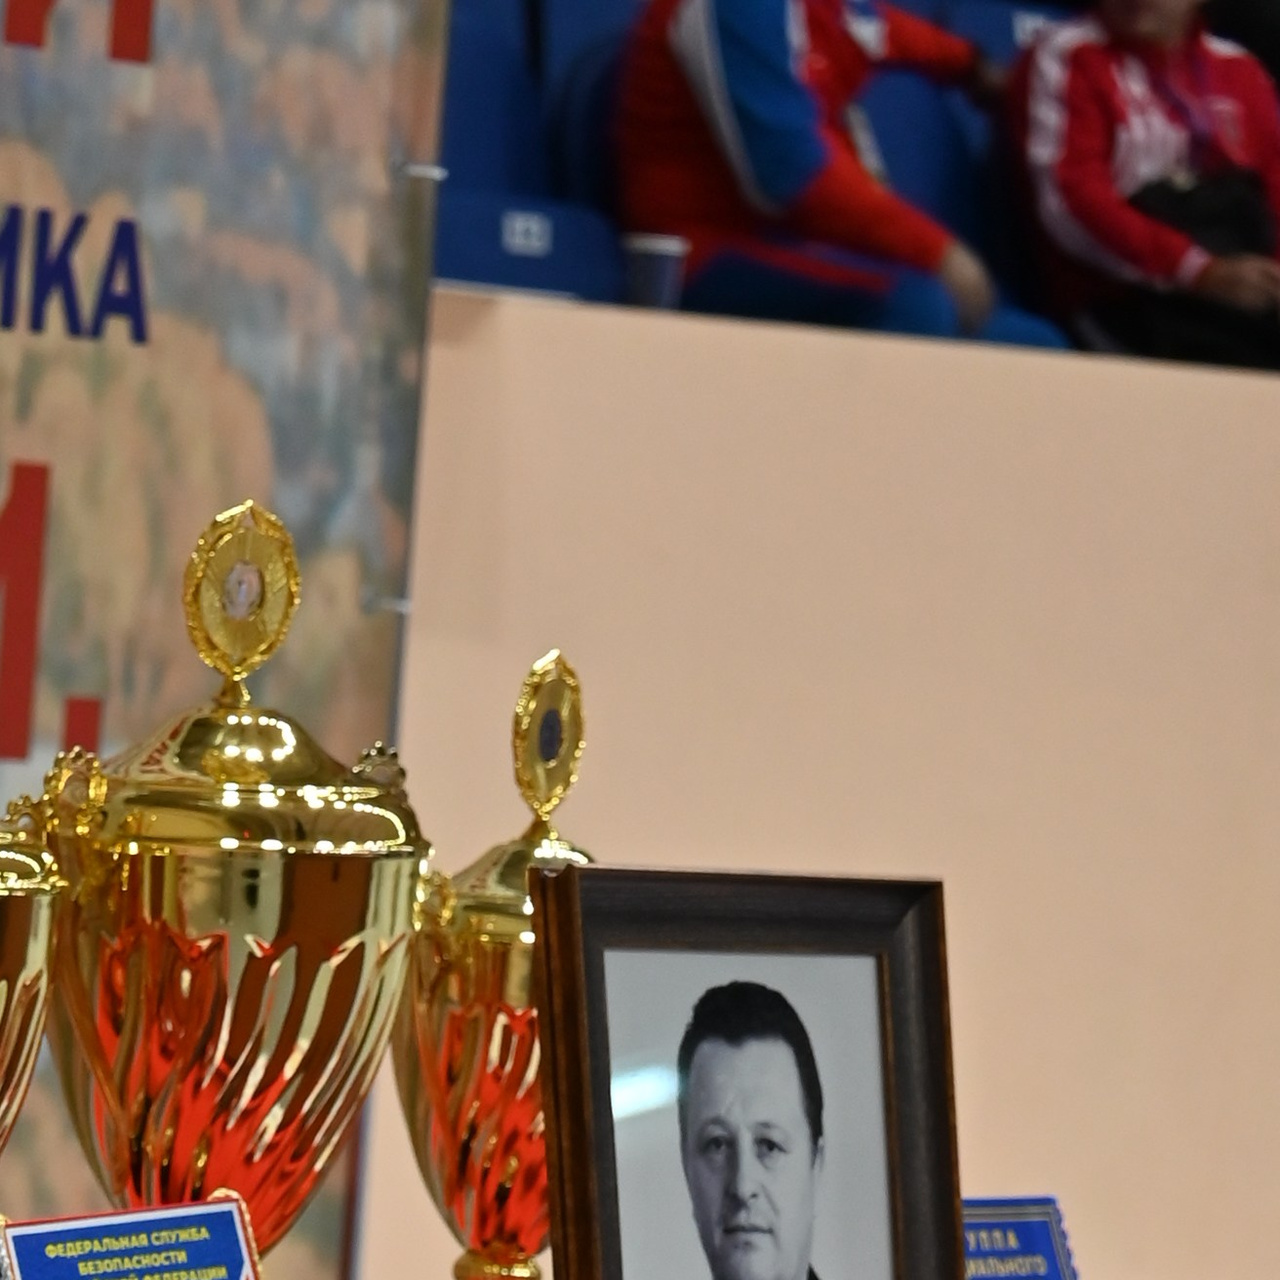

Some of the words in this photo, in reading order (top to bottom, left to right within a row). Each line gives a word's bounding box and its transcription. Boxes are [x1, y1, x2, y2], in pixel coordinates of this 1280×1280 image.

[45, 1233, 149, 1258] ФЕДЕРАЛЬНАЯ
[151, 1226, 210, 1246] СЛУЖБА
[78, 1250, 188, 1276] БЕЗОПАСНОСТИ
